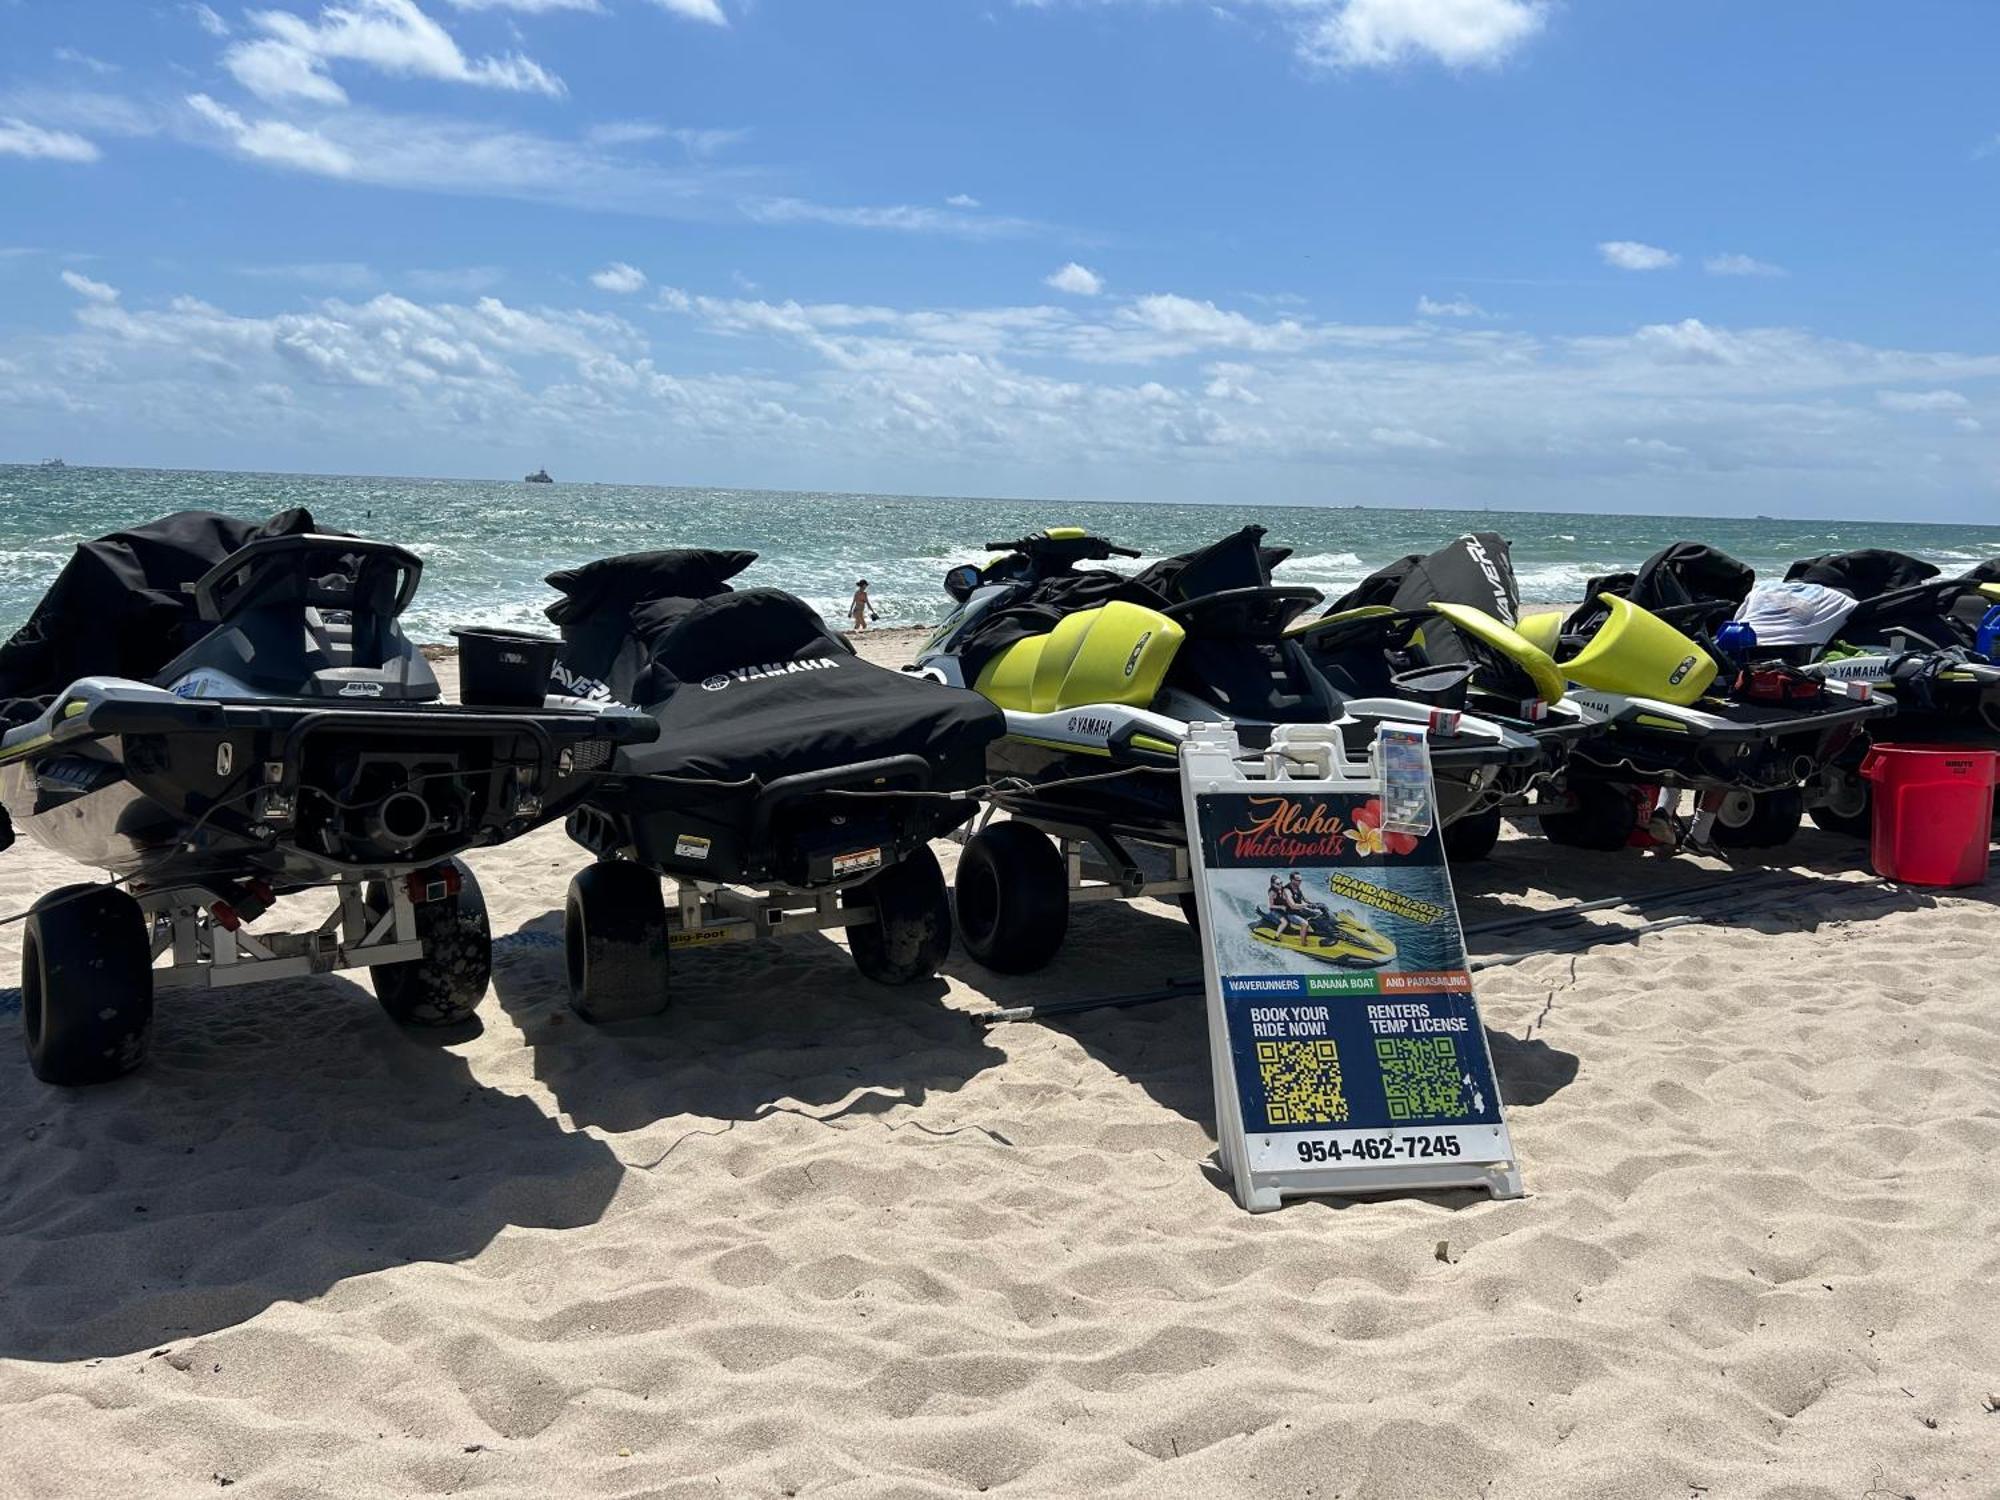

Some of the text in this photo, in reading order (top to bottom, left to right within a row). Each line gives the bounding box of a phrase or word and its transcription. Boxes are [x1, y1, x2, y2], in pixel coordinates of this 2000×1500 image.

[729, 658, 840, 681] YAMAHA
[1840, 666, 1884, 677] YAMAHA
[1077, 717, 1112, 736] YAMAHA
[1235, 795, 1343, 837] Aloha
[1220, 831, 1346, 864] Watersports
[1331, 873, 1377, 895] BRAND
[1378, 887, 1412, 906] NEW
[1330, 882, 1432, 924] WAVERUNNERS!
[1229, 976, 1466, 991] WAVERUNNERS BANANA BOAT AND PARASAILING
[1250, 1006, 1329, 1022] BOOK YOUR
[1367, 1003, 1430, 1019] RENTERS
[1253, 1021, 1328, 1037] RIDE NOW!
[1370, 1017, 1469, 1034] TEMP LICENSE
[1297, 1135, 1461, 1163] 954-462-7245
